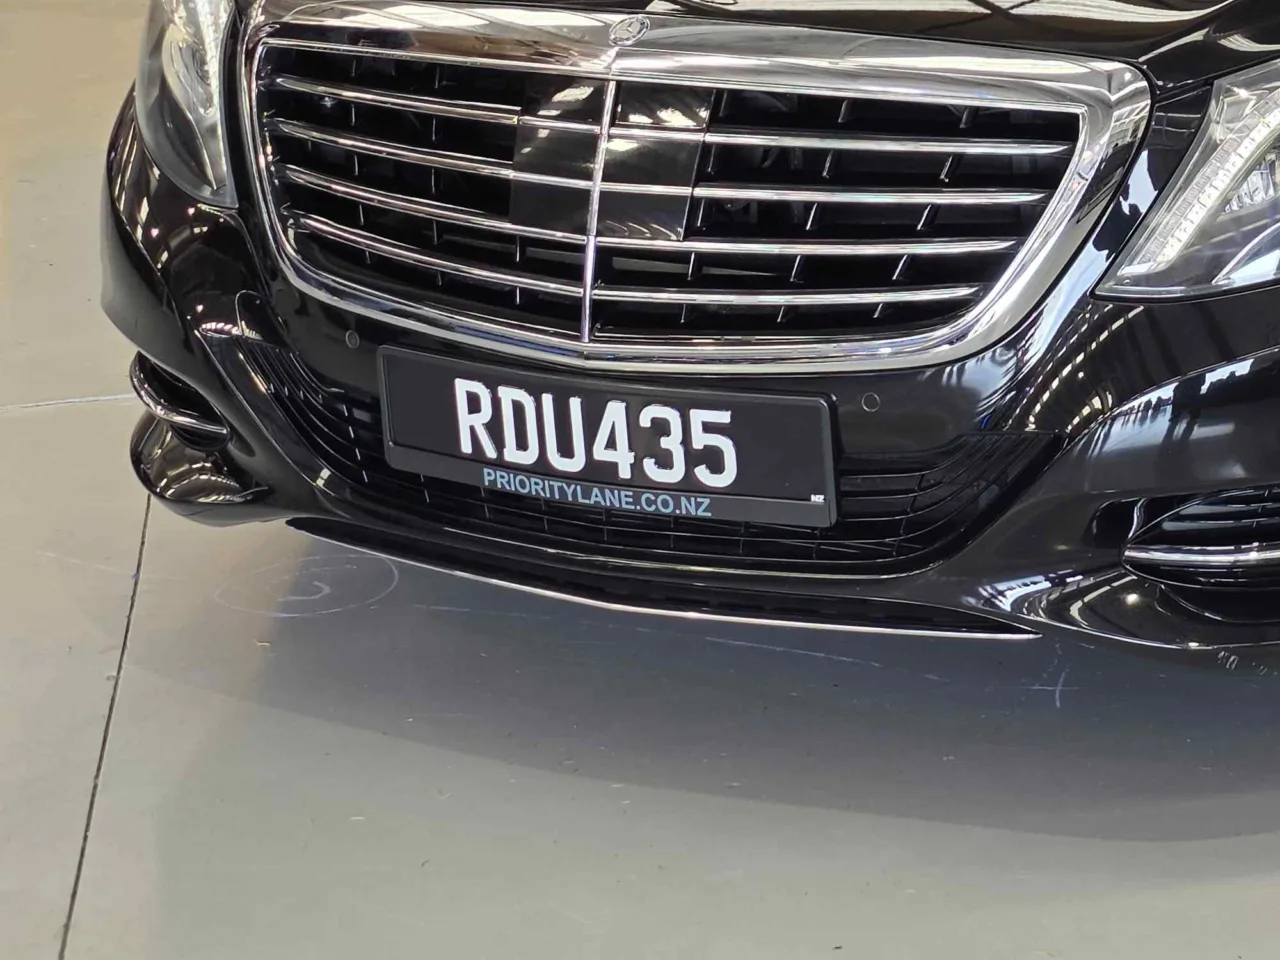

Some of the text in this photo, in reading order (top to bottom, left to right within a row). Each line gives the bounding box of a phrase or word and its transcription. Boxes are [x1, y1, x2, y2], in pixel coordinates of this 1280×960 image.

[453, 377, 737, 488] RDU435
[482, 467, 712, 517] PRIORITYLANE.CO.NZ
[811, 494, 825, 502] NZ
